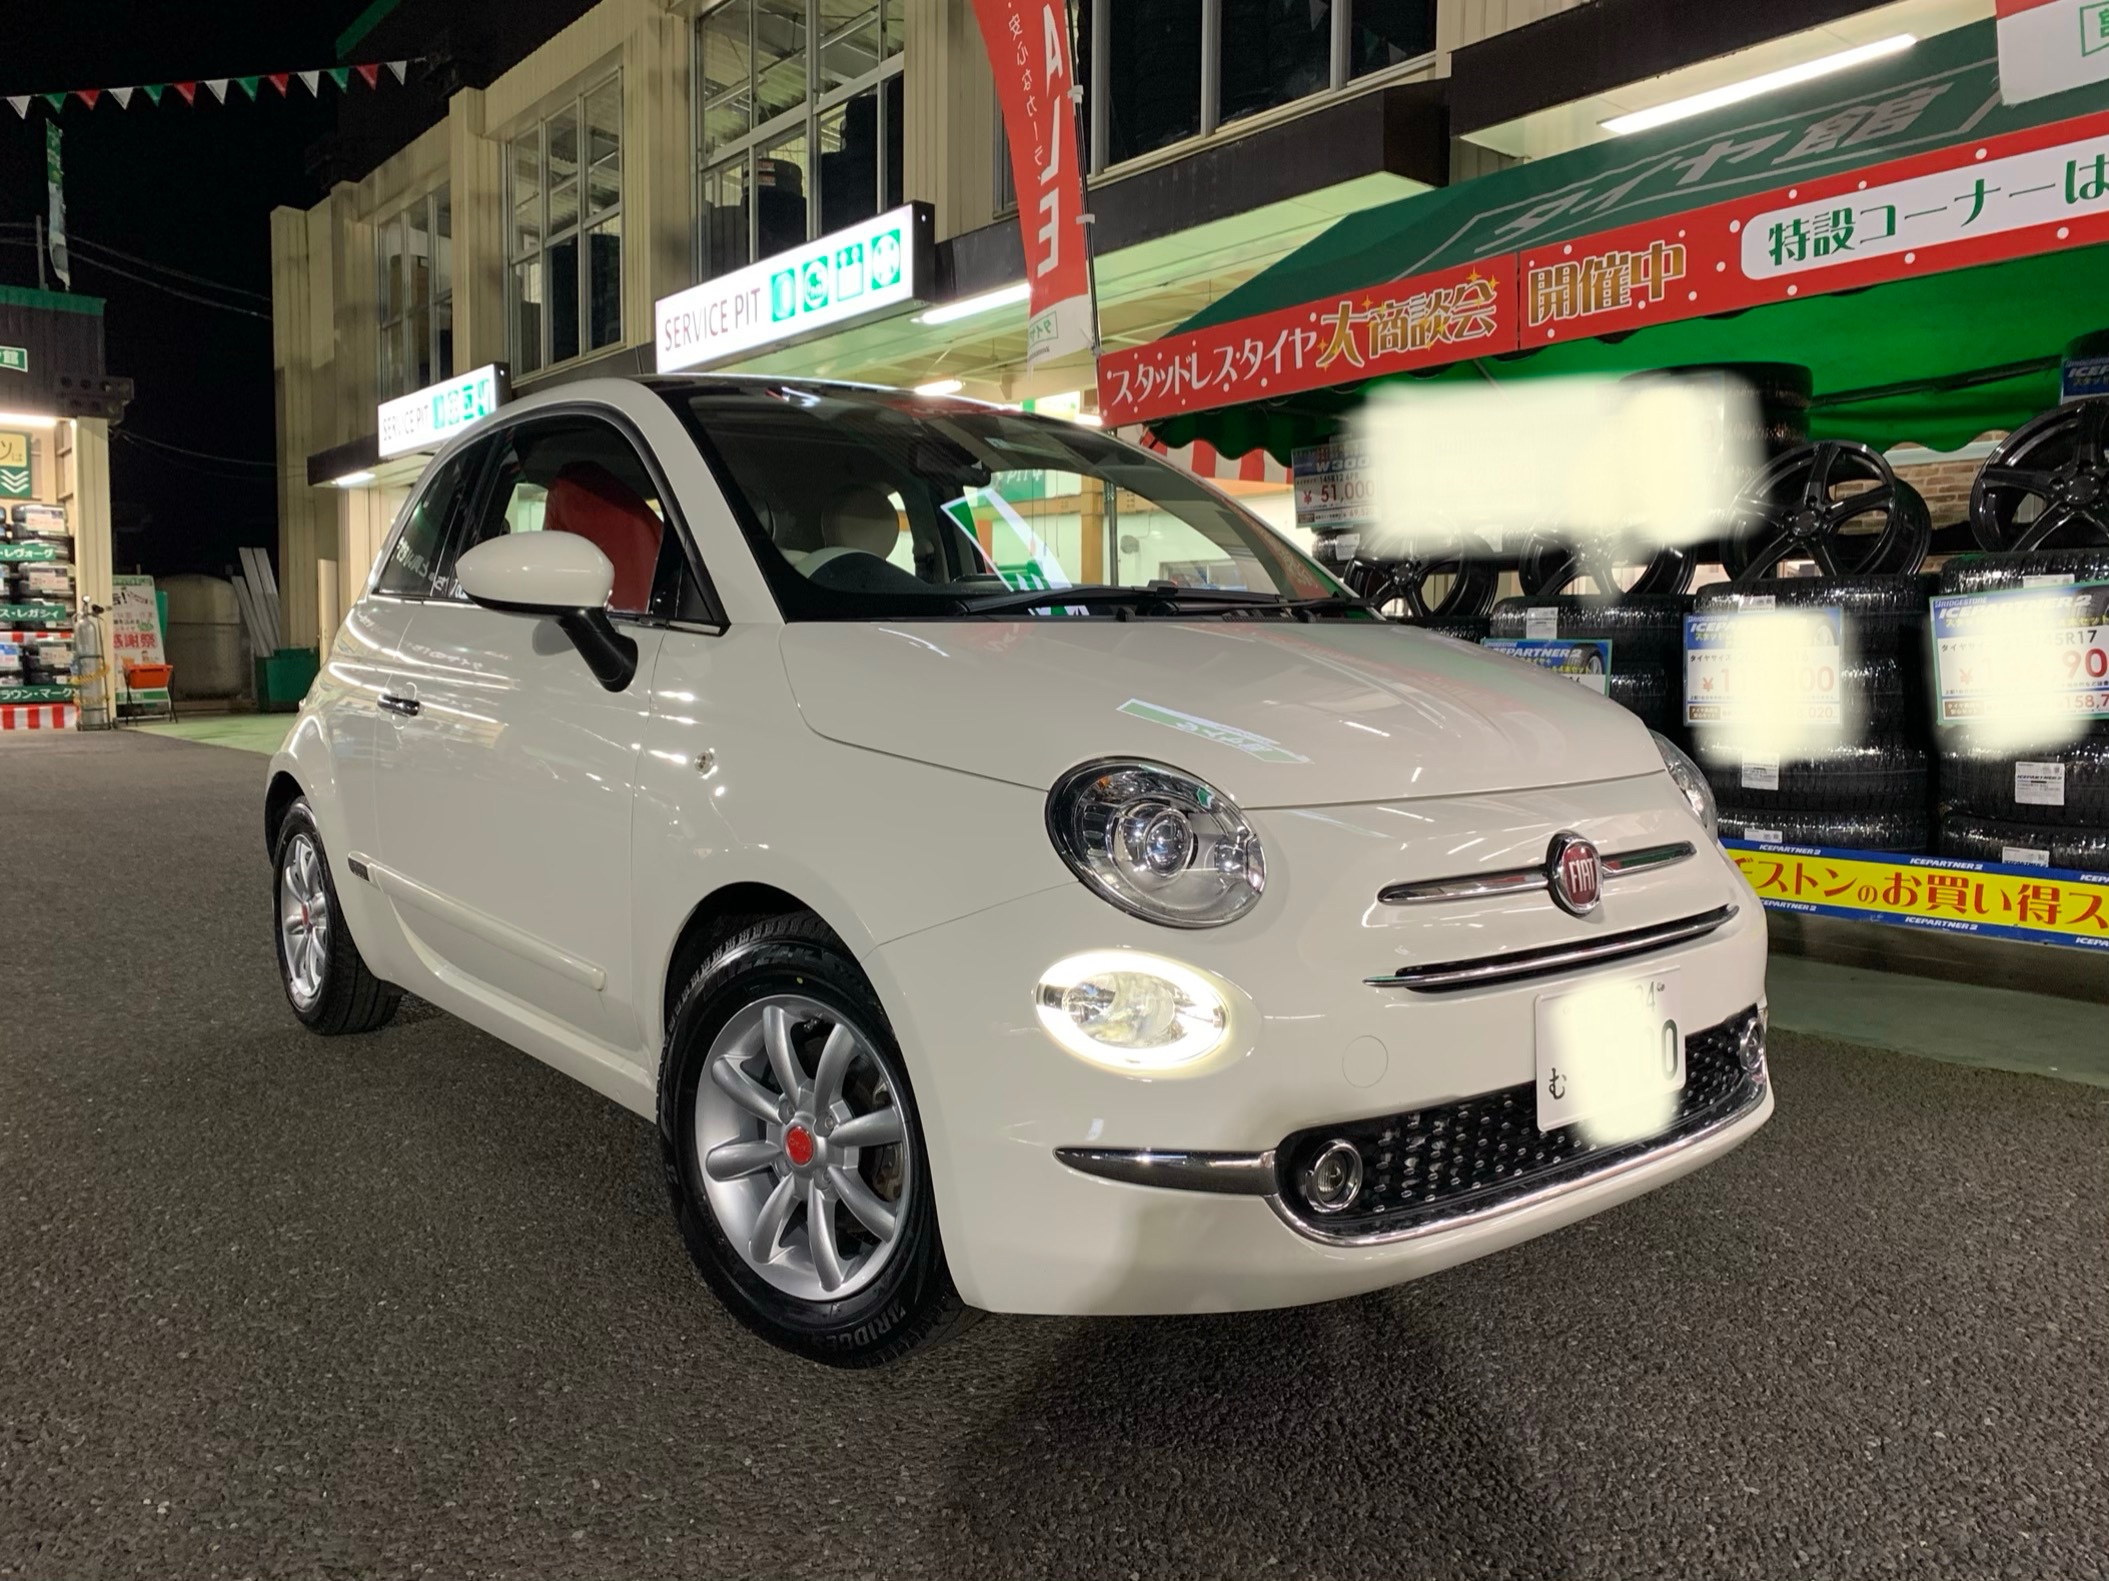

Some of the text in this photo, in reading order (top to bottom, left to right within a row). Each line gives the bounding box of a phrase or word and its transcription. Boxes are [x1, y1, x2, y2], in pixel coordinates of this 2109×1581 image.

[1494, 82, 1953, 237] タイヤ館
[1528, 239, 1686, 327] 開催中
[1769, 154, 2109, 266] 特設コーナーは
[664, 287, 761, 352] SERVICE PIT
[0, 350, 19, 365] 館
[1569, 856, 1595, 895] FIAT
